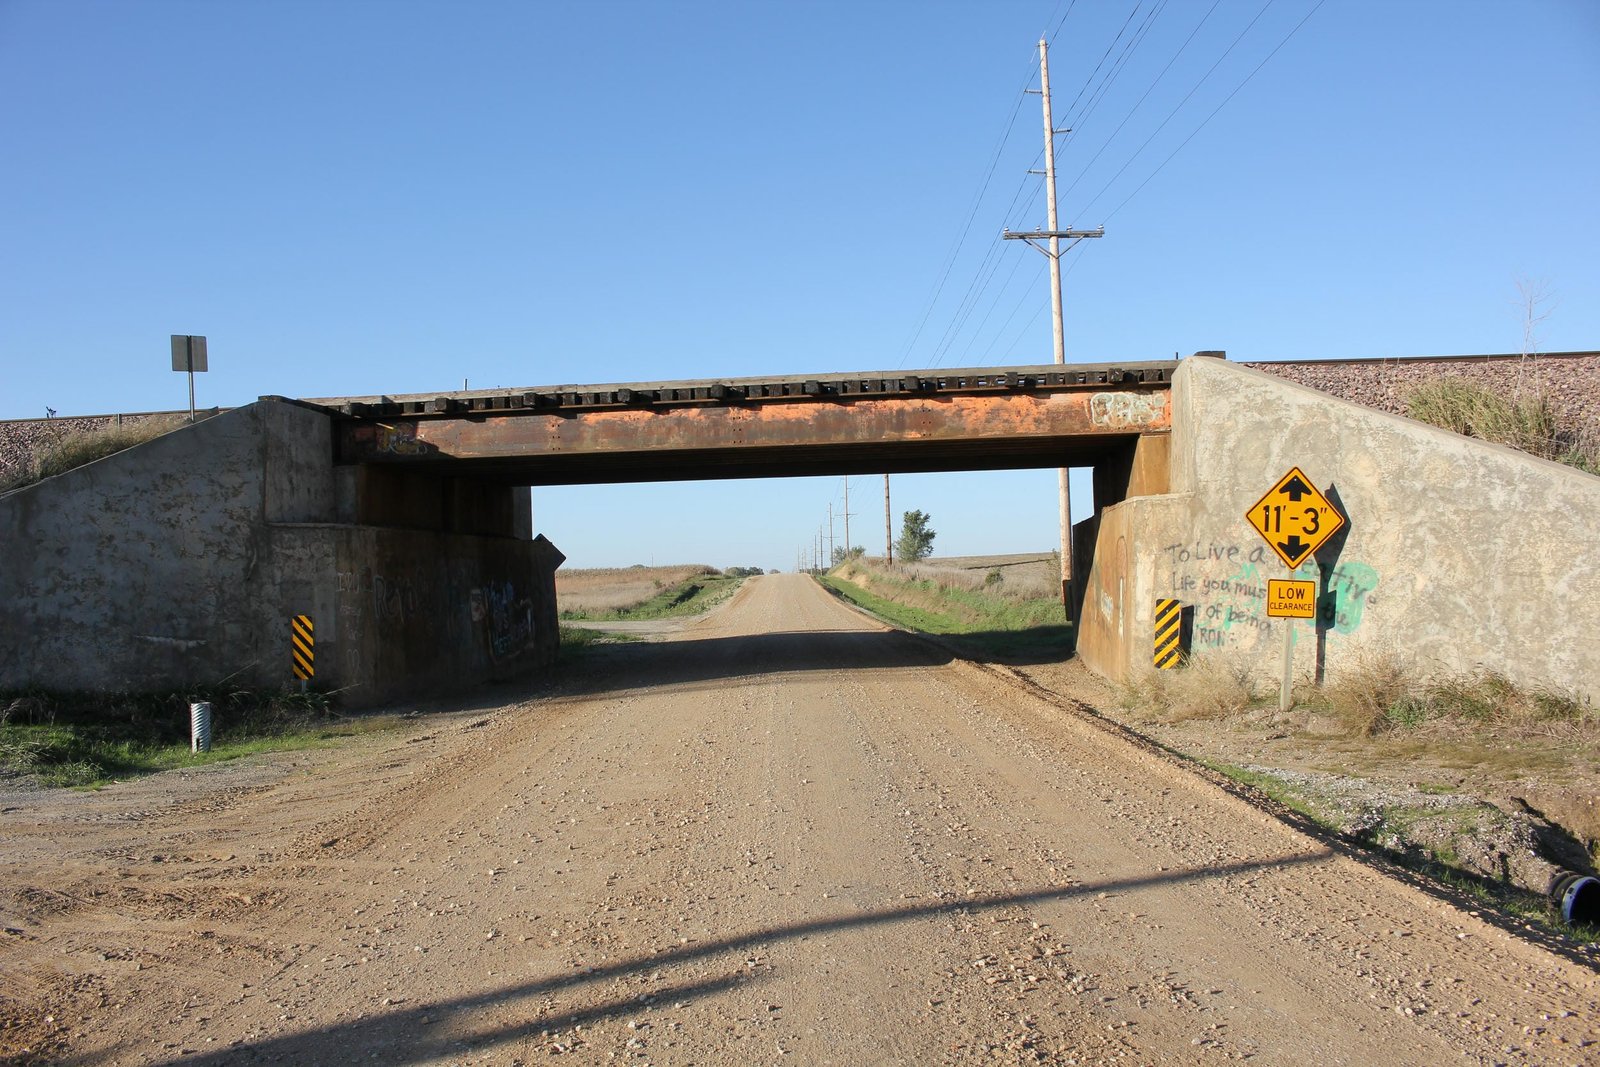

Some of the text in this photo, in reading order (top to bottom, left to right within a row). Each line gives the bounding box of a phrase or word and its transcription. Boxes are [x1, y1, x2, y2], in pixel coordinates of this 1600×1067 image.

[1164, 543, 1190, 564] To
[1196, 542, 1239, 563] Live
[1249, 546, 1266, 565] a
[1172, 572, 1196, 591] Life
[1203, 578, 1231, 595] you
[1234, 583, 1267, 599] mus
[1278, 587, 1305, 600] LOW
[1269, 601, 1313, 612] CLEARANCE
[1228, 605, 1271, 636] being
